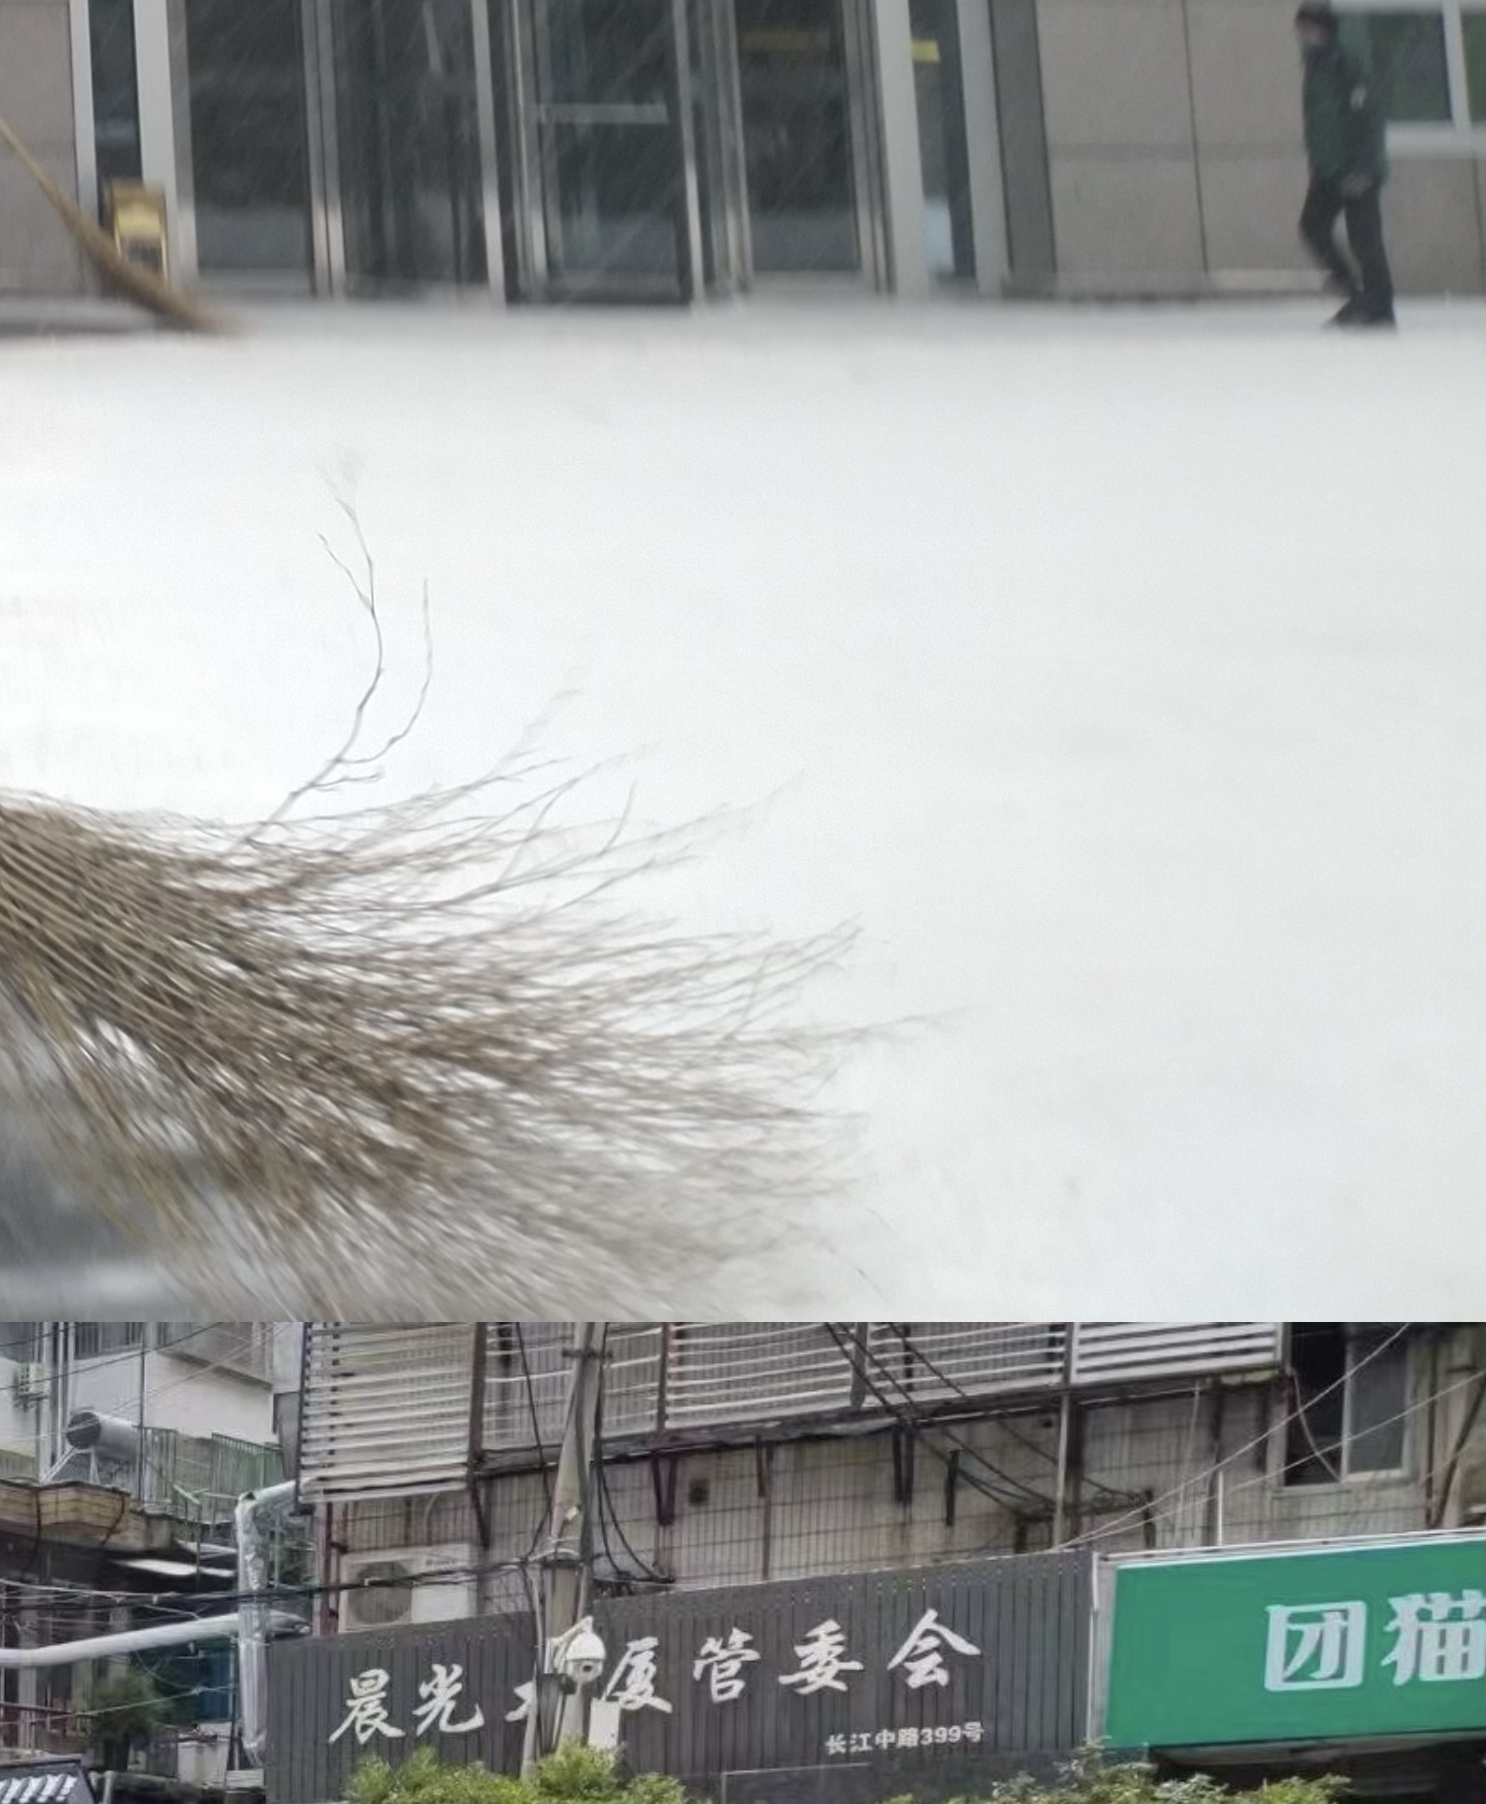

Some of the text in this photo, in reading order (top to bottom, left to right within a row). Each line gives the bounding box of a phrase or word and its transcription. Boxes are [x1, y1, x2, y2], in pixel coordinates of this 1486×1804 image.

[328, 1608, 981, 1745] 晨光厦管委会
[1264, 1589, 1486, 1692] 团猫
[826, 1721, 985, 1755] 长江中路399号
